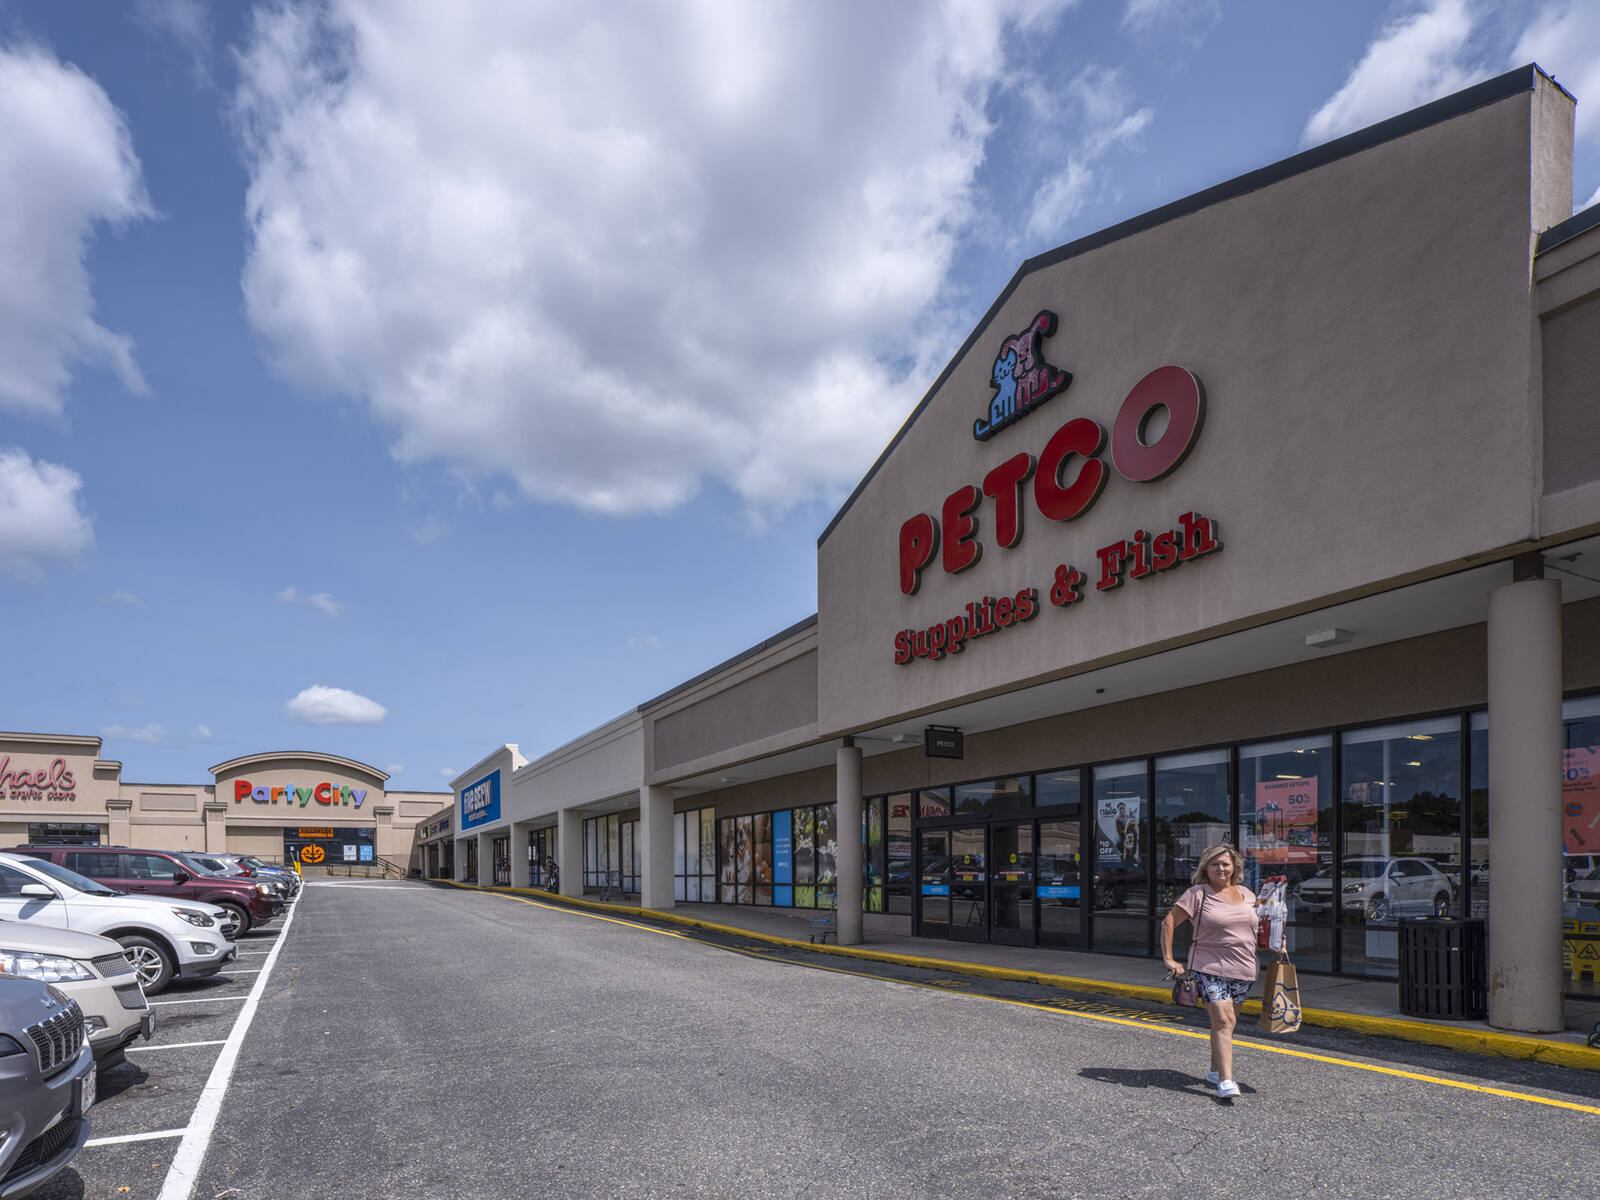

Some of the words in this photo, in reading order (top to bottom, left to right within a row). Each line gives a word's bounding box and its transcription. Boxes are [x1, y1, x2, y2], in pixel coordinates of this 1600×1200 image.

[899, 365, 1206, 595] PETCO
[894, 586, 1040, 665] Supplies
[1050, 564, 1087, 606] &
[1096, 511, 1224, 591] Fish
[10, 789, 42, 801] crafts
[47, 790, 76, 801] store
[235, 780, 313, 807] Party
[315, 782, 367, 808] City
